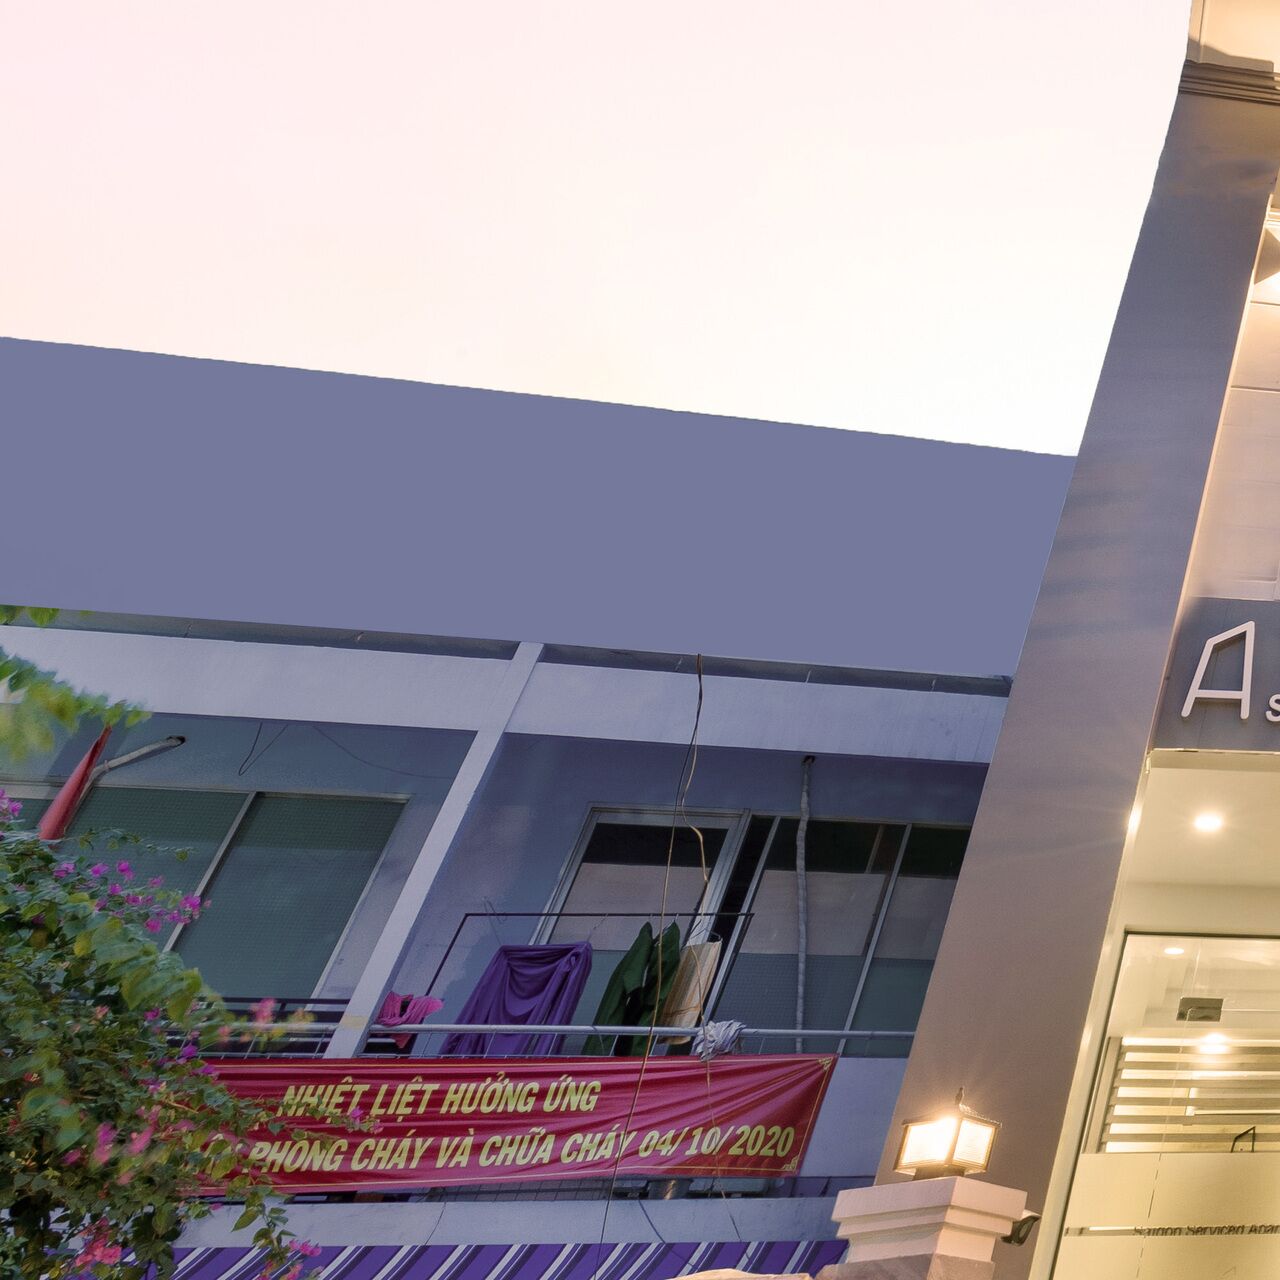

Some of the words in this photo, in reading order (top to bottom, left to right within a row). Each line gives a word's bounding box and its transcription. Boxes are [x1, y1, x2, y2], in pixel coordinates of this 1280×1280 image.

[276, 1075, 370, 1124] NHIỆT
[369, 1075, 440, 1123] LIỆT
[440, 1071, 540, 1114] HƯỞNG
[543, 1074, 601, 1112] ỨNG
[351, 1128, 434, 1171] CHÁY
[436, 1128, 475, 1168] VÀ
[479, 1127, 556, 1167] CHỮA
[561, 1123, 637, 1163] CHÁY
